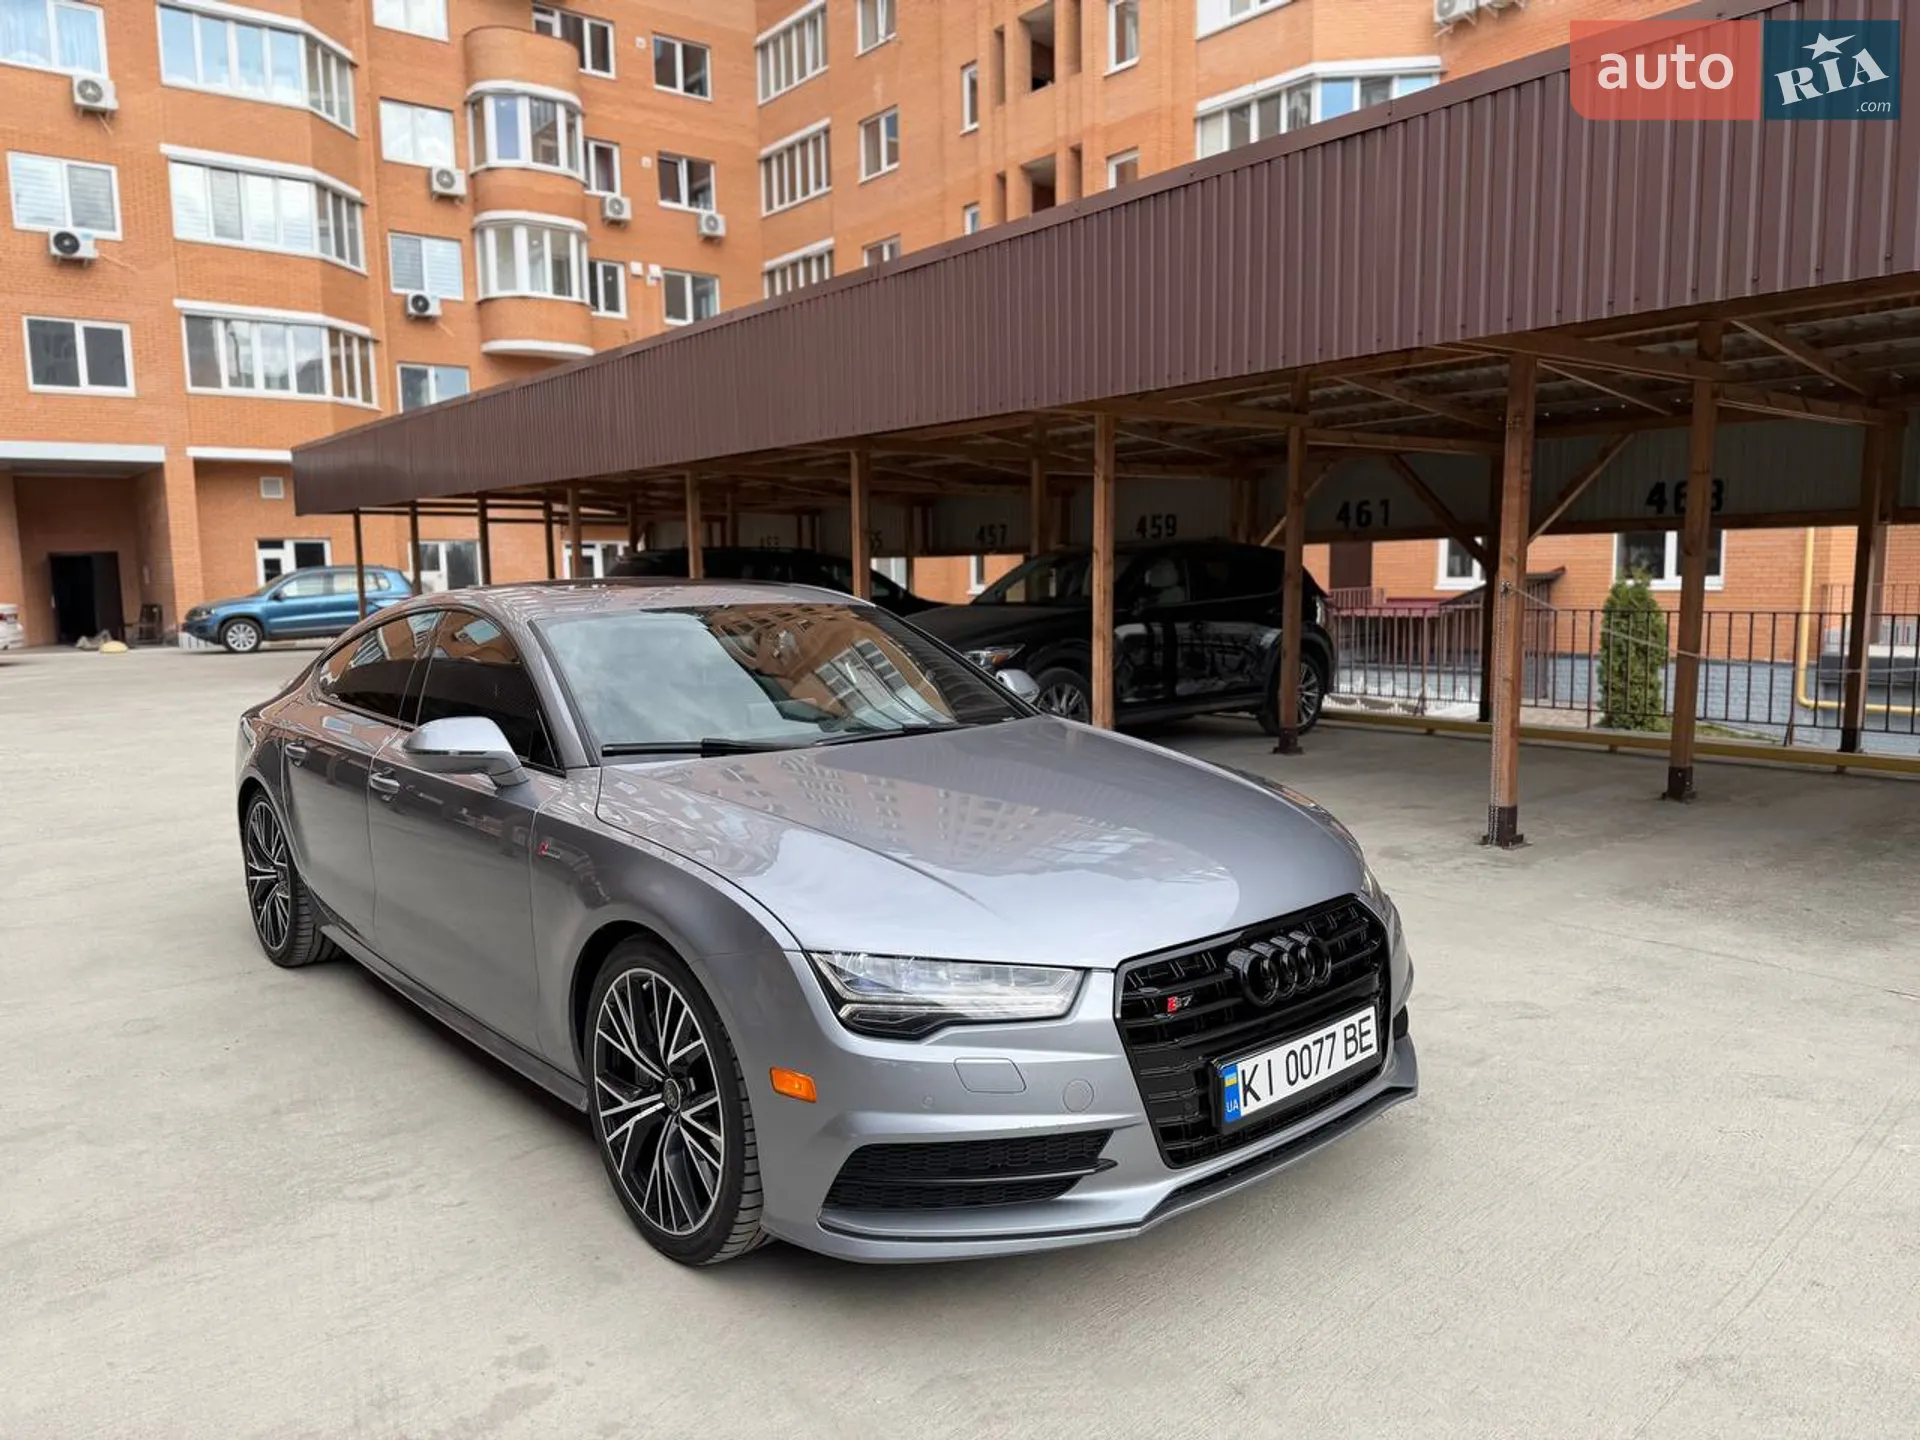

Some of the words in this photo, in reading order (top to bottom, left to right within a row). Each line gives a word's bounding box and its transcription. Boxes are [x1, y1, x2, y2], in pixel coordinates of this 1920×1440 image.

[1336, 498, 1389, 529] 461
[976, 523, 1008, 547] 457
[1136, 514, 1177, 539] 459
[1241, 1058, 1272, 1108] KI
[1285, 1031, 1336, 1087] 0077
[1343, 1015, 1374, 1061] BE
[1226, 1099, 1239, 1112] UA
